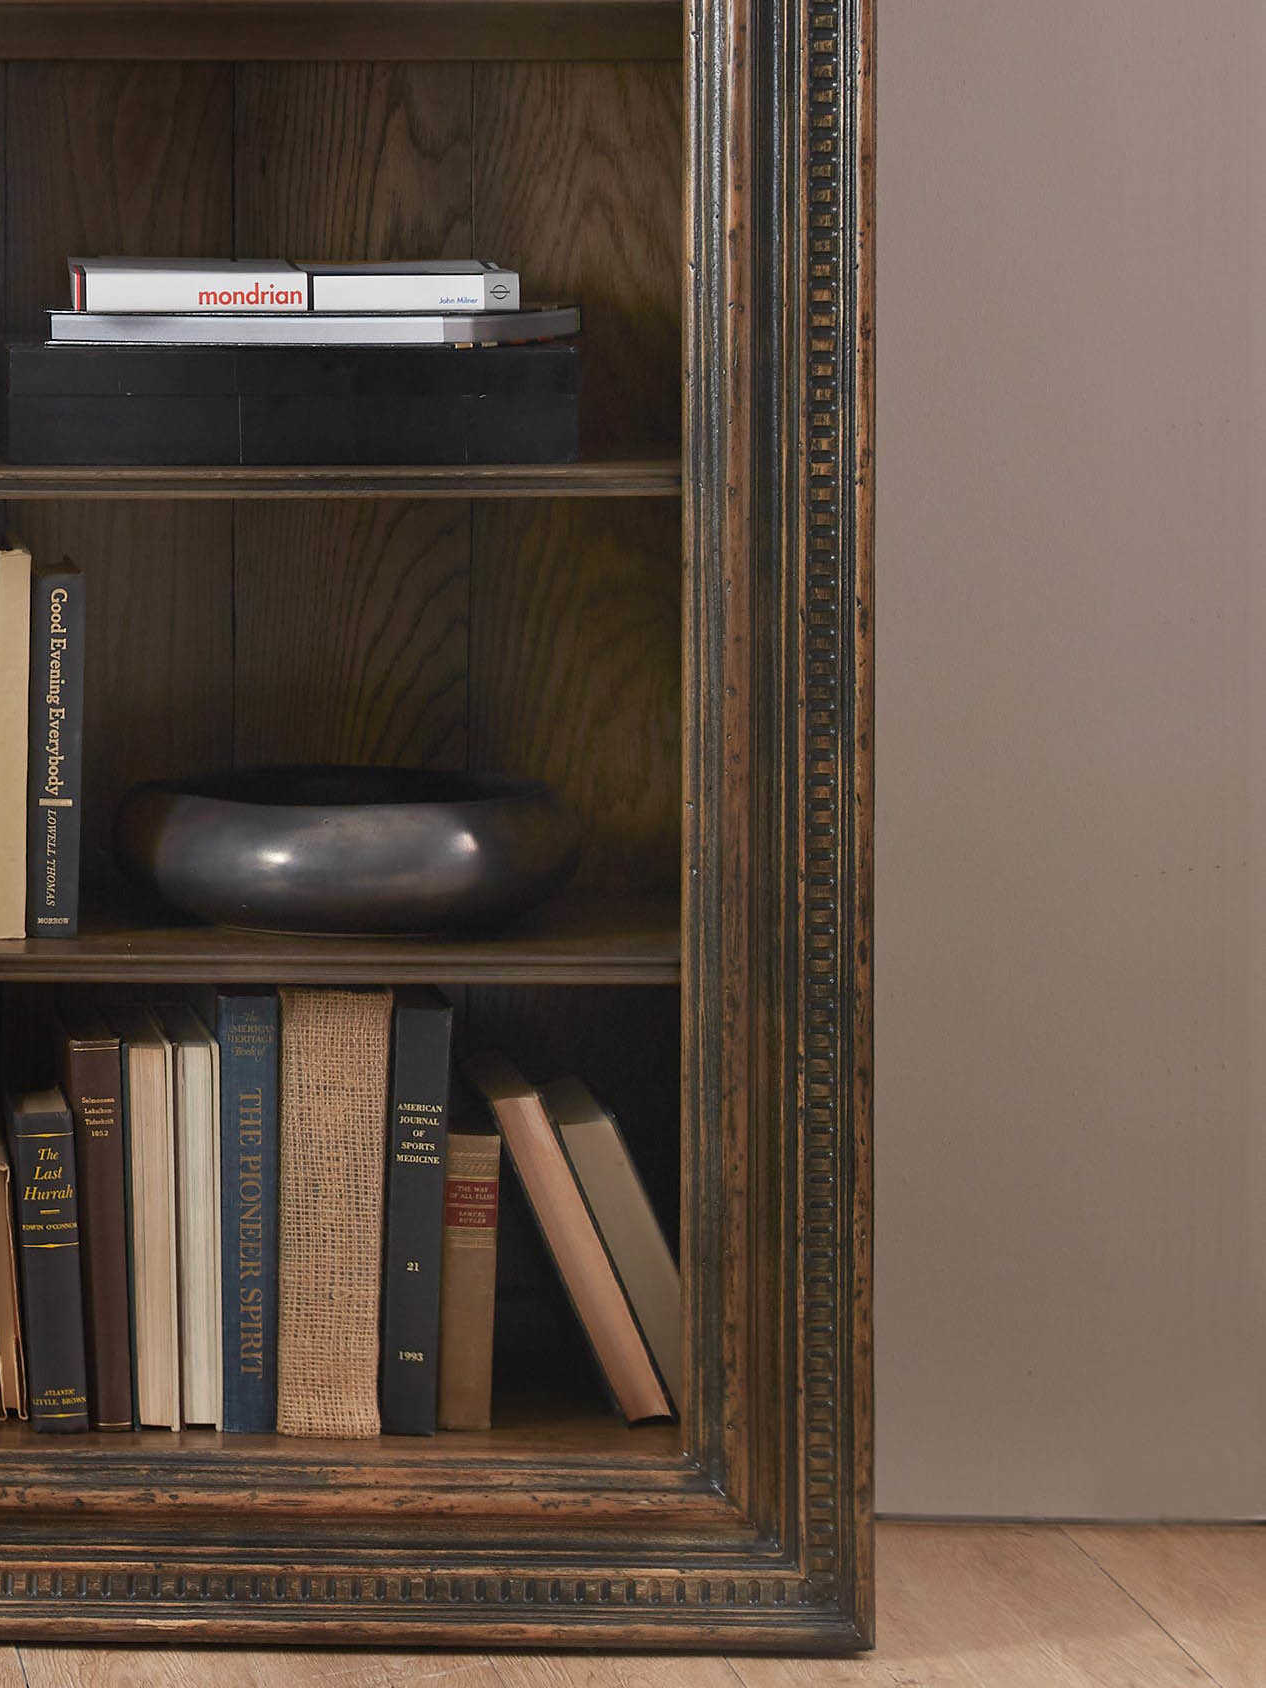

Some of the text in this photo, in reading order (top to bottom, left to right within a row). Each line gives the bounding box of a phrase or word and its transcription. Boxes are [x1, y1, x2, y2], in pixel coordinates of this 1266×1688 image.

[198, 282, 302, 305] mondrian
[45, 588, 68, 795] Good Evening Everybody
[45, 808, 57, 907] LOWELL THOMAS
[397, 1103, 443, 1113] AMERICAN
[399, 1115, 440, 1126] JOURNAL
[412, 1129, 426, 1137] OF
[400, 1141, 435, 1152] SPORTS
[38, 1148, 60, 1161] The
[396, 1153, 440, 1164] MEDICINE
[33, 1166, 63, 1180] Last
[24, 1183, 74, 1200] Hurrah
[238, 1088, 263, 1381] THE PIONEER SPIRIT
[407, 1261, 420, 1272] 21
